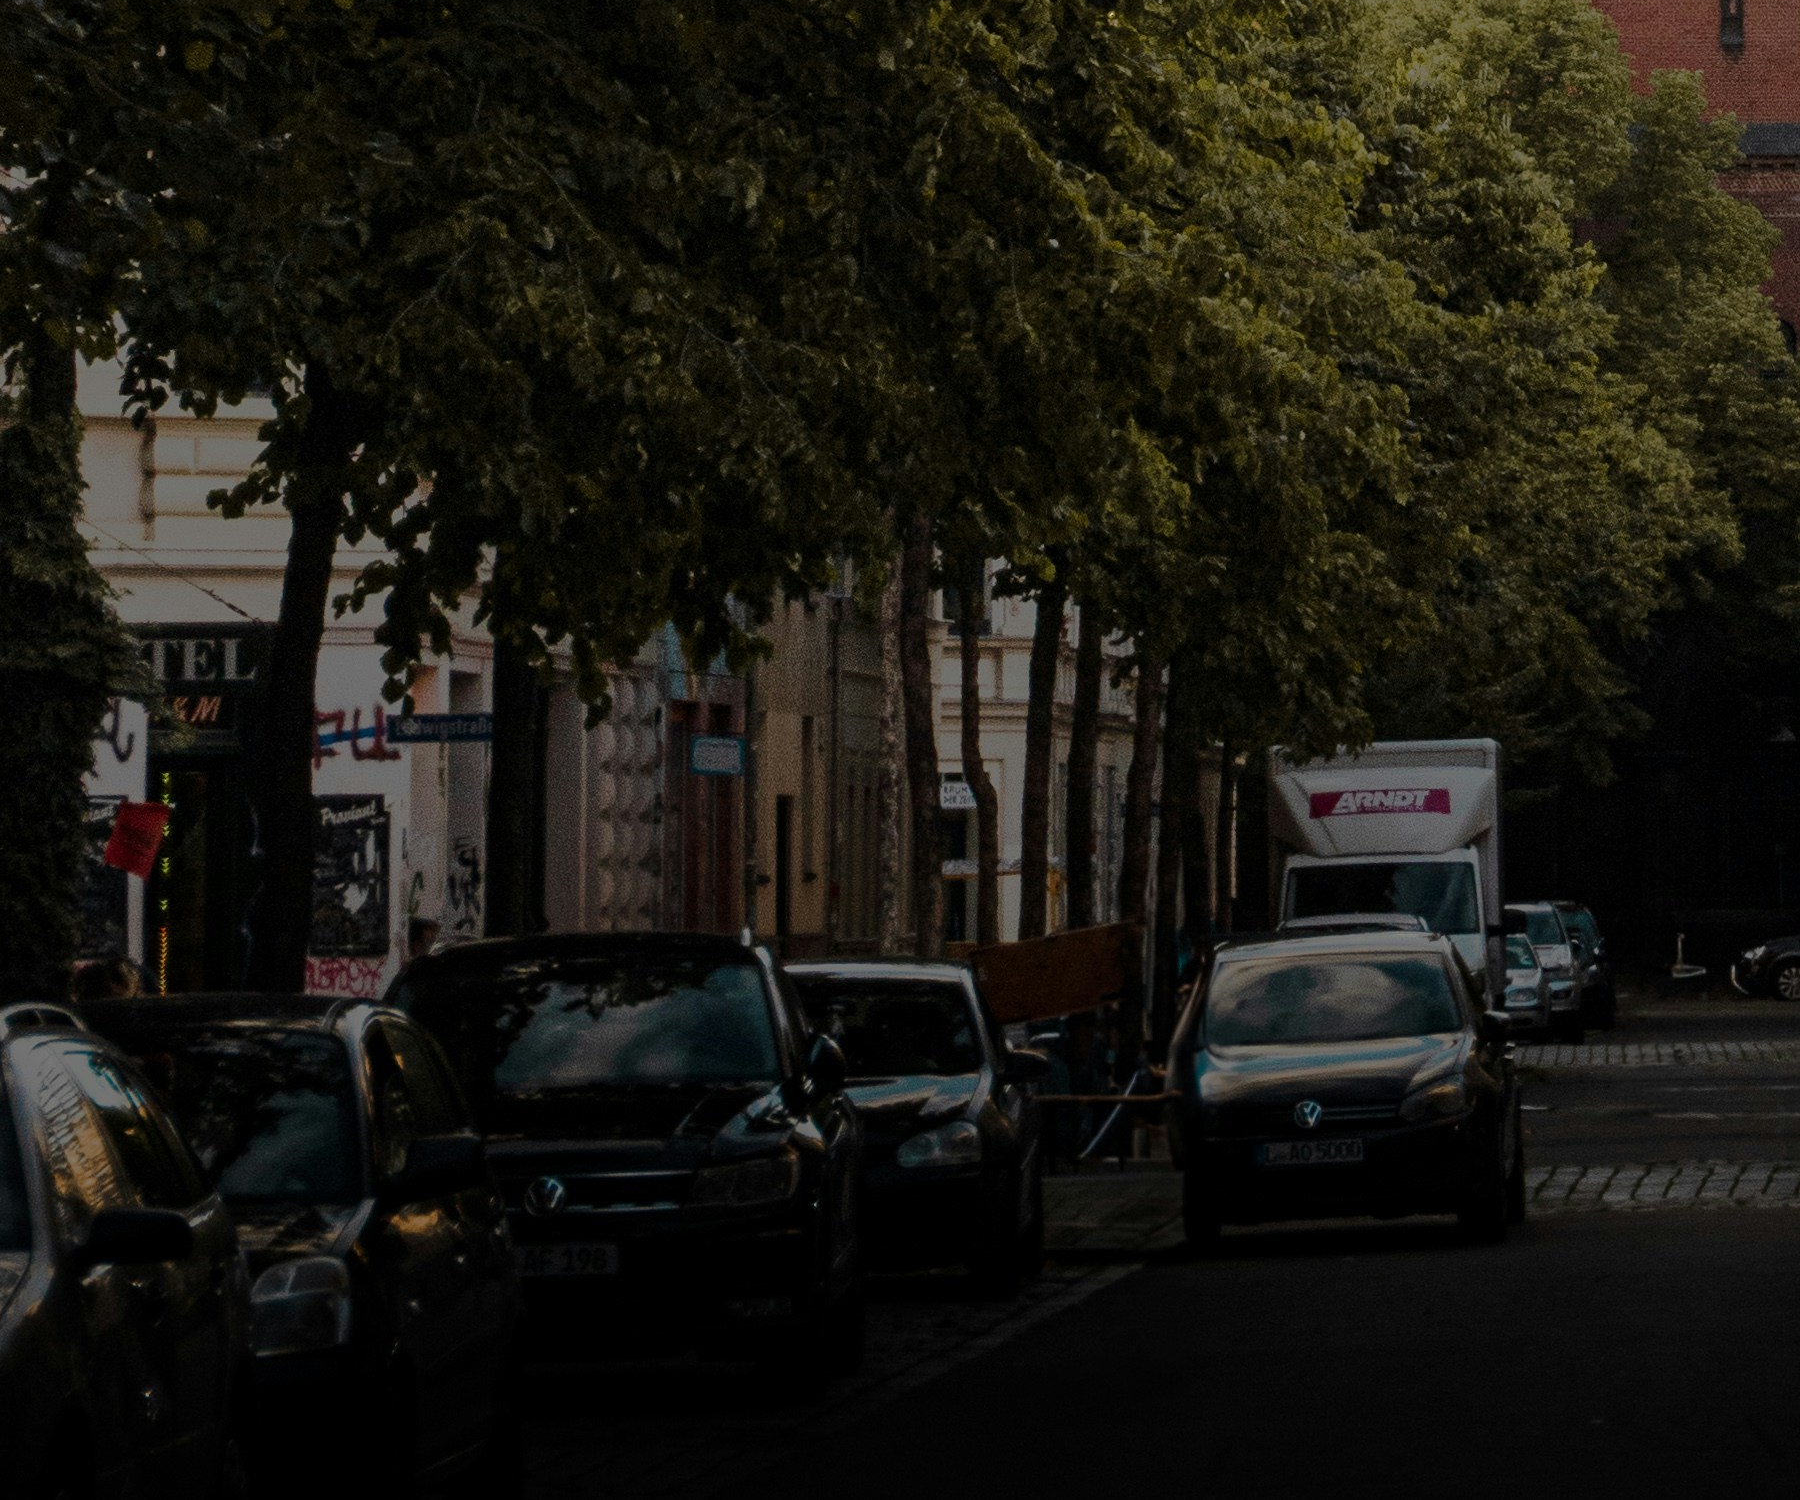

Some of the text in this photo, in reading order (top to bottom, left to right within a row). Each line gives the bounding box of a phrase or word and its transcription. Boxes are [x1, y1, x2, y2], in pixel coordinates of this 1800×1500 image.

[395, 715, 494, 739] Lwigstraß
[1332, 789, 1429, 814] ARNDT
[1315, 1140, 1362, 1161] 5000
[560, 1246, 608, 1273] 198
